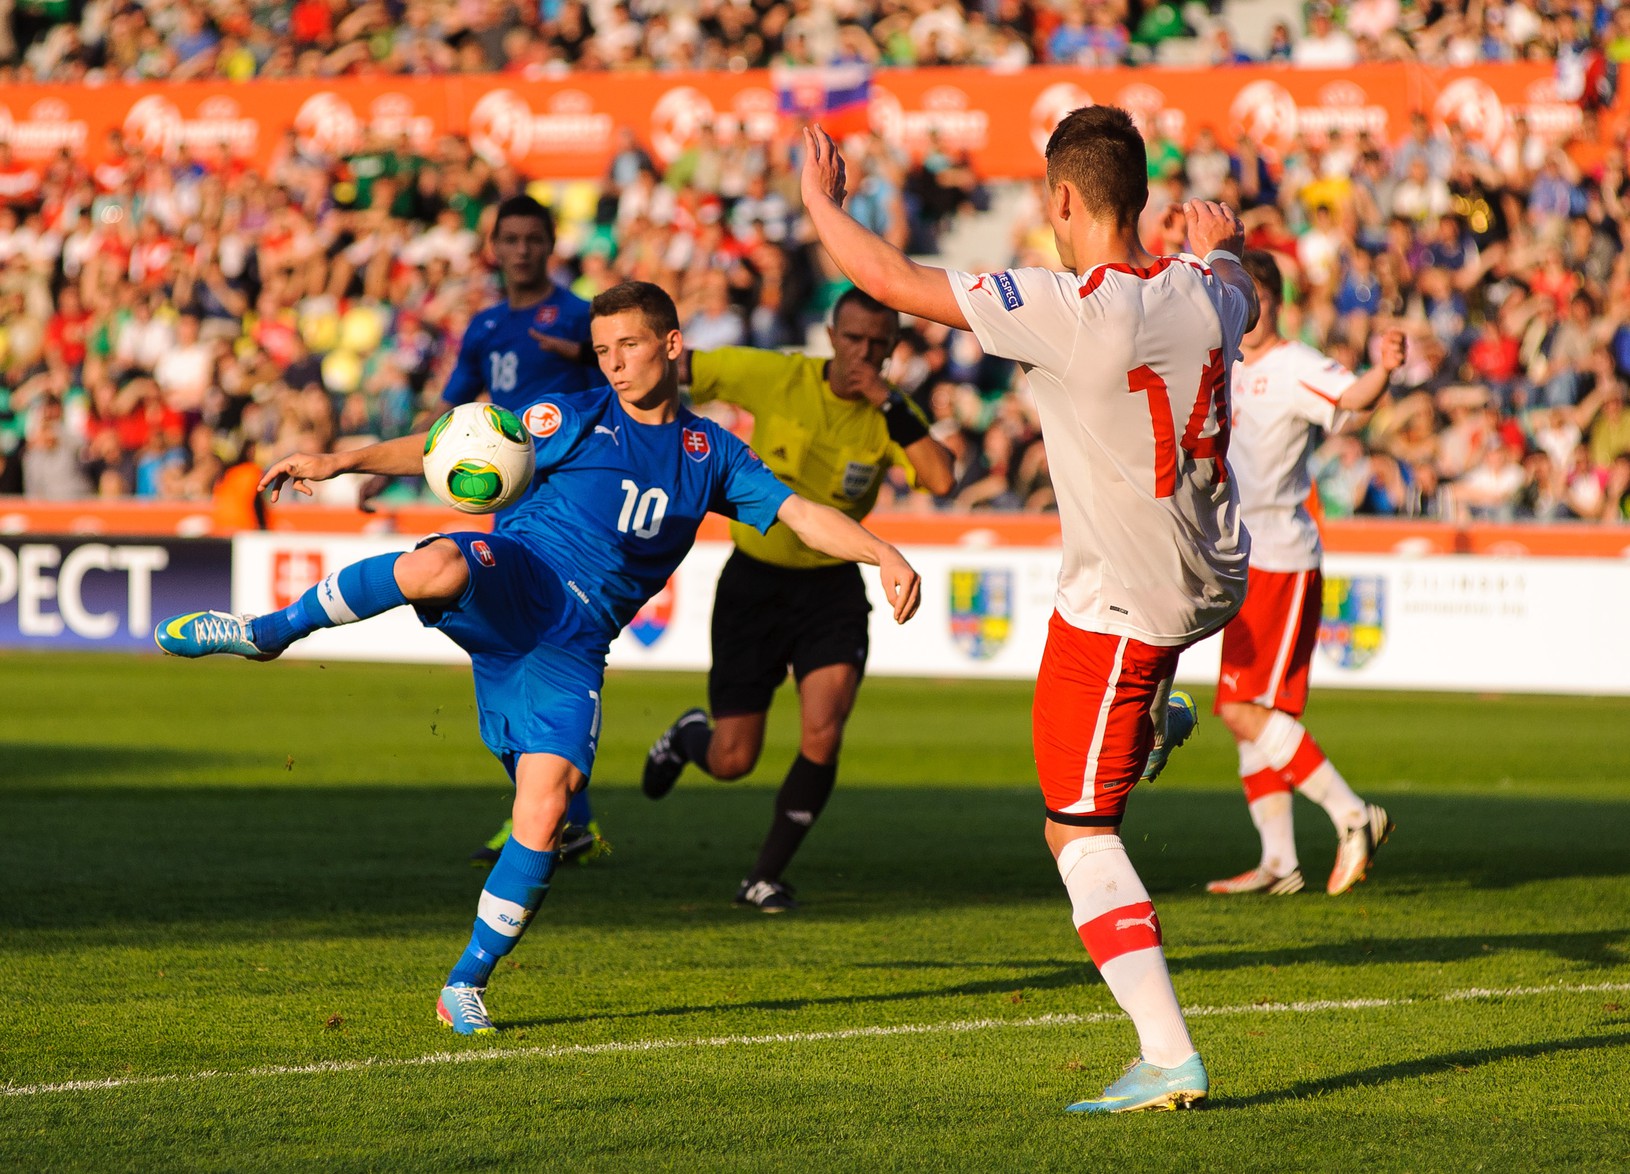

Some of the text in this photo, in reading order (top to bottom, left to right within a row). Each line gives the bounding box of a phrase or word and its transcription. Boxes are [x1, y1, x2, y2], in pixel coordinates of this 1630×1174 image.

[489, 351, 518, 391] 18
[1127, 347, 1228, 498] 14
[617, 479, 669, 539] 10
